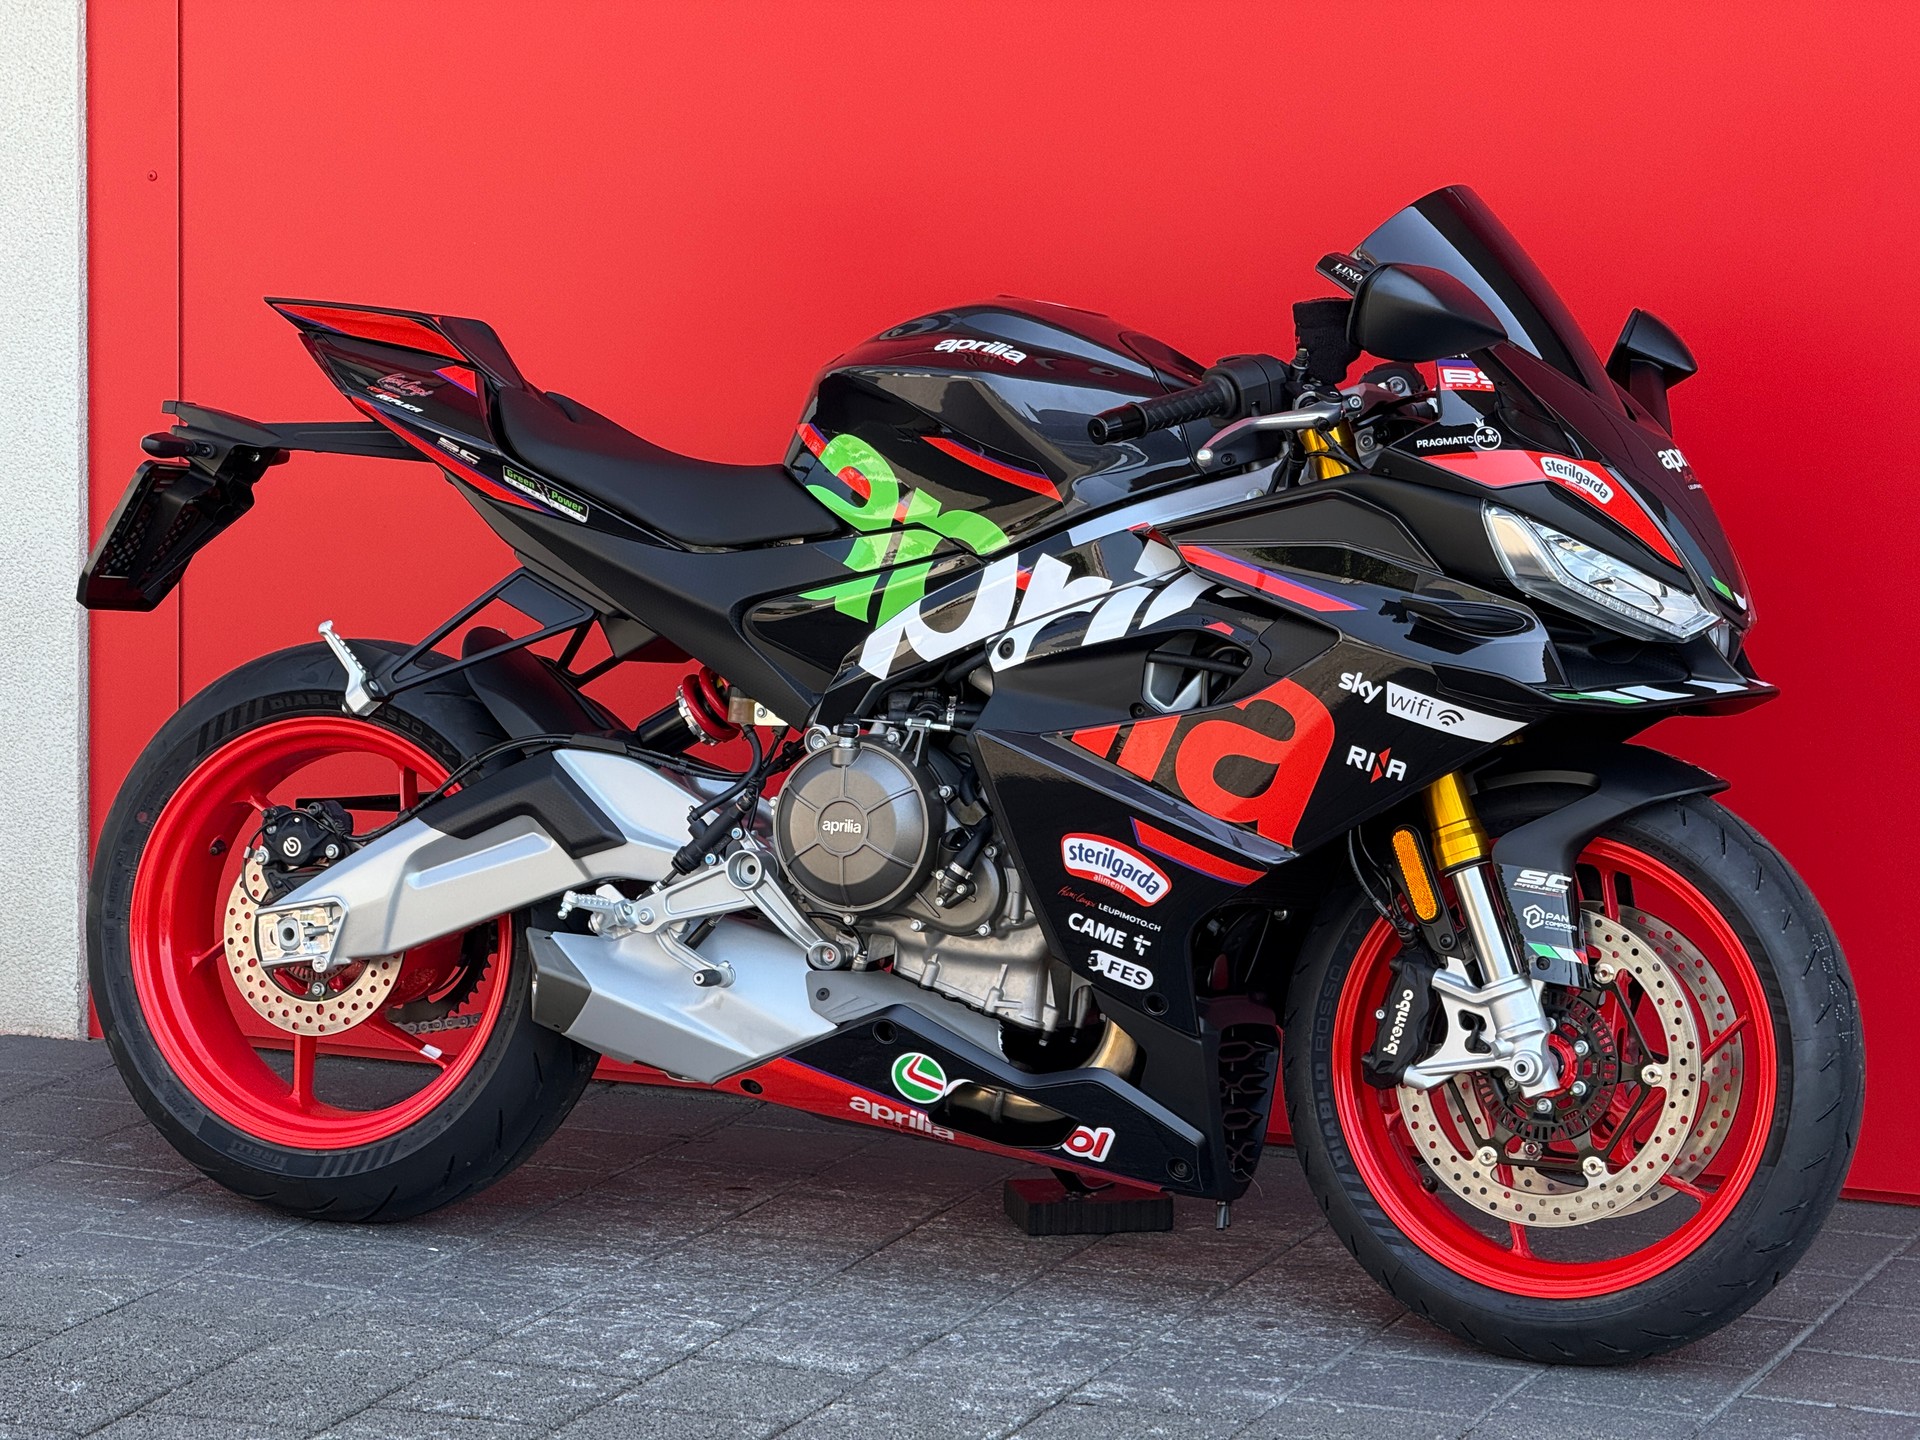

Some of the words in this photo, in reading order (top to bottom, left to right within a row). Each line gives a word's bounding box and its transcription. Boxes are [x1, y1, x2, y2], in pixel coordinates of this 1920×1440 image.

[1335, 263, 1363, 280] LINO
[934, 339, 1027, 364] aprilia
[375, 394, 423, 413] REPLICA
[1416, 435, 1475, 448] PRAGMATIC
[1477, 434, 1498, 443] PLAY
[506, 468, 535, 489] Green
[551, 490, 584, 513] Power
[1545, 460, 1609, 499] sterilgarda
[1338, 671, 1383, 704] sky
[1391, 692, 1434, 720] wifi
[822, 819, 862, 835] aprilia
[1068, 842, 1160, 896] sterilgarda
[1093, 873, 1127, 893] alimenti
[1516, 869, 1572, 890] SC
[1513, 882, 1567, 894] PROJECT
[1068, 912, 1128, 949] CAME
[1098, 902, 1162, 933] LEUPIMOTO.CH
[1545, 912, 1570, 923] PAN
[1107, 960, 1148, 986] FES
[1314, 964, 1343, 1052] ROSSO
[1383, 989, 1414, 1055] brembo
[849, 1095, 955, 1141] aprilia
[1313, 1062, 1350, 1173] DIABLO
